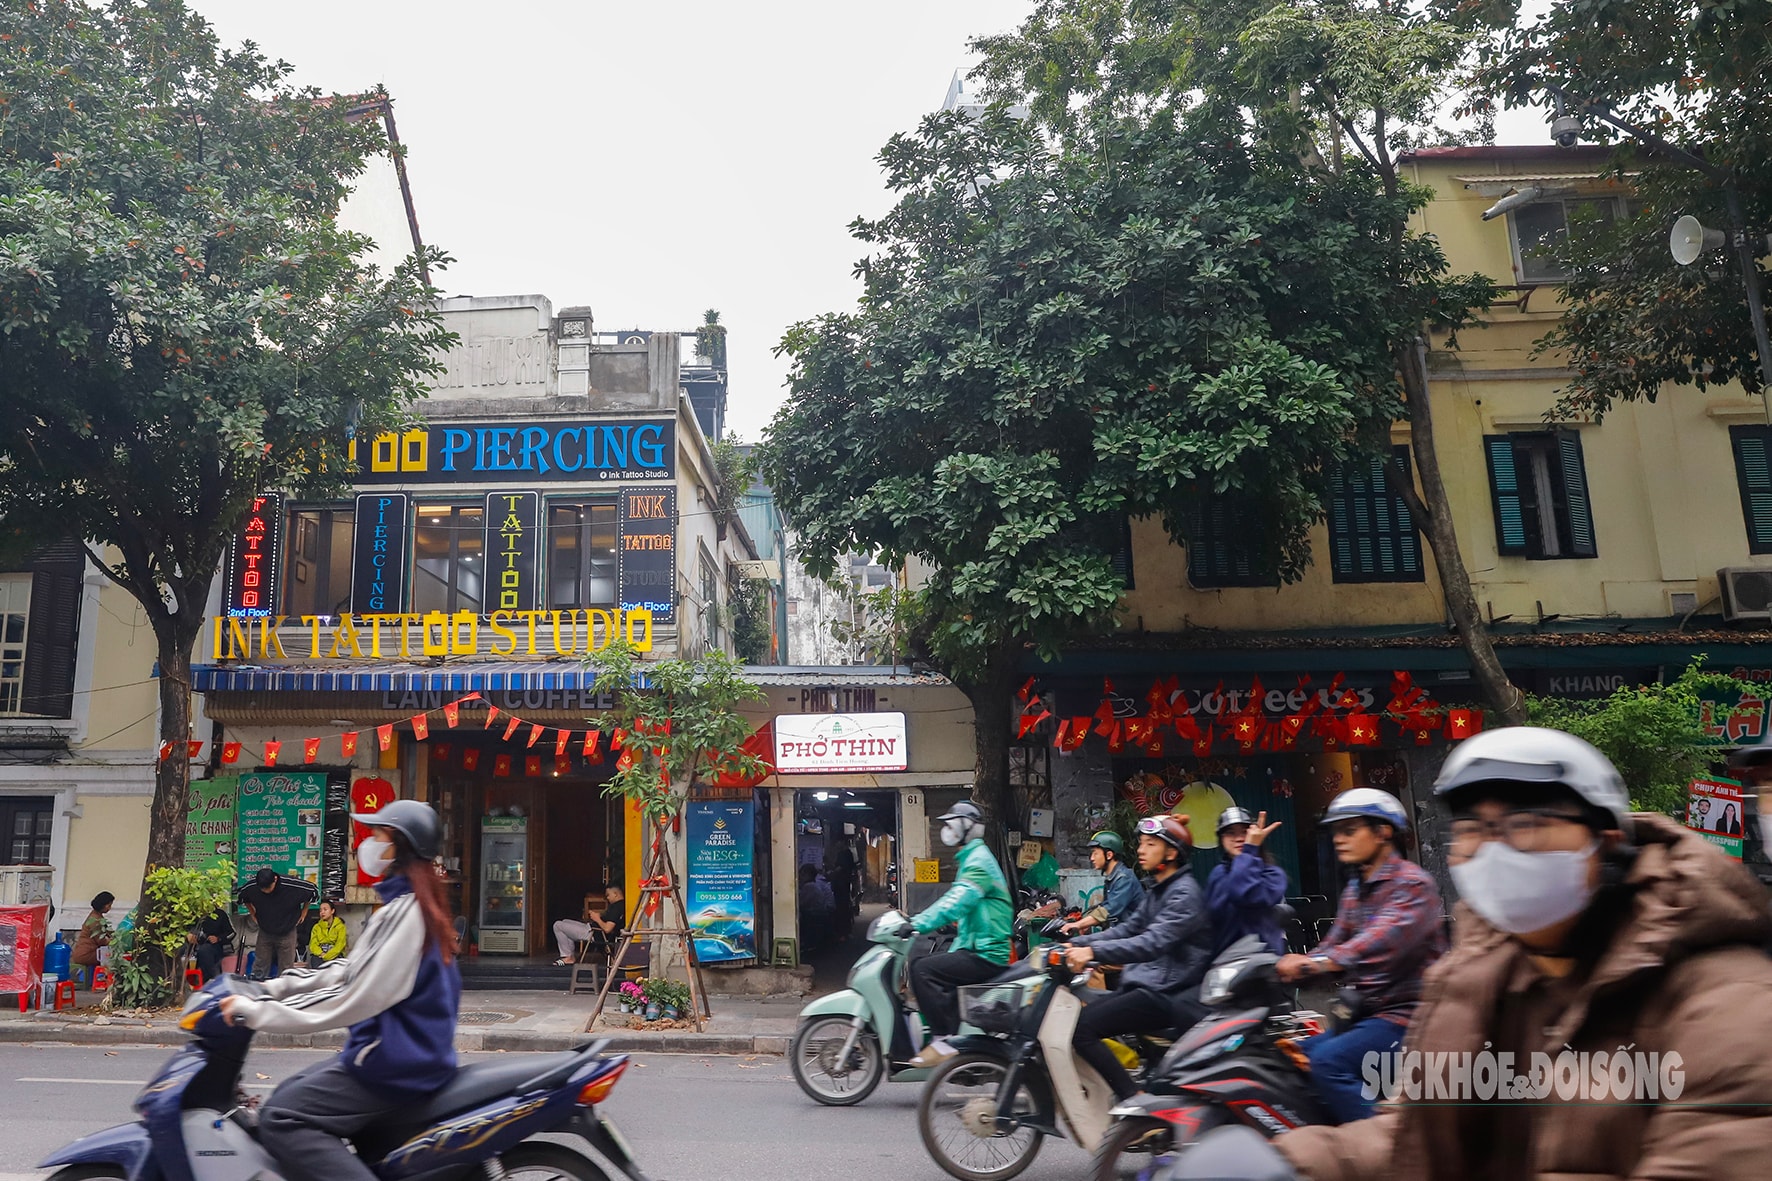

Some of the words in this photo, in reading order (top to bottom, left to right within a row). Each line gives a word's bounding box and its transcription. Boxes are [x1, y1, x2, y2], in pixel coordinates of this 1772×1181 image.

[440, 425, 666, 474] PIERCING
[609, 471, 620, 479] Ink
[621, 470, 644, 479] Tattoo
[644, 470, 669, 478] Studio
[628, 495, 667, 518] INK
[623, 534, 672, 550] TATTOO
[243, 498, 266, 607] TATTOO
[369, 498, 392, 610] PIERCING
[499, 495, 524, 609] TATTOO
[622, 570, 671, 586] STUDIO
[230, 608, 246, 617] 2nd
[248, 608, 269, 617] Floor
[644, 602, 671, 611] Floor
[212, 614, 289, 660] INK
[302, 608, 478, 659] TATTOO
[490, 607, 654, 656] STUDIO
[1549, 674, 1625, 694] KHANG
[382, 689, 441, 709] LAN
[503, 689, 614, 709] COFFEE
[780, 734, 828, 758] PHỞ
[831, 733, 897, 757] THÌN
[243, 777, 264, 796] Cà
[907, 795, 918, 804] 61
[200, 821, 233, 835] CHANH
[1707, 835, 1739, 847] PASSPORT
